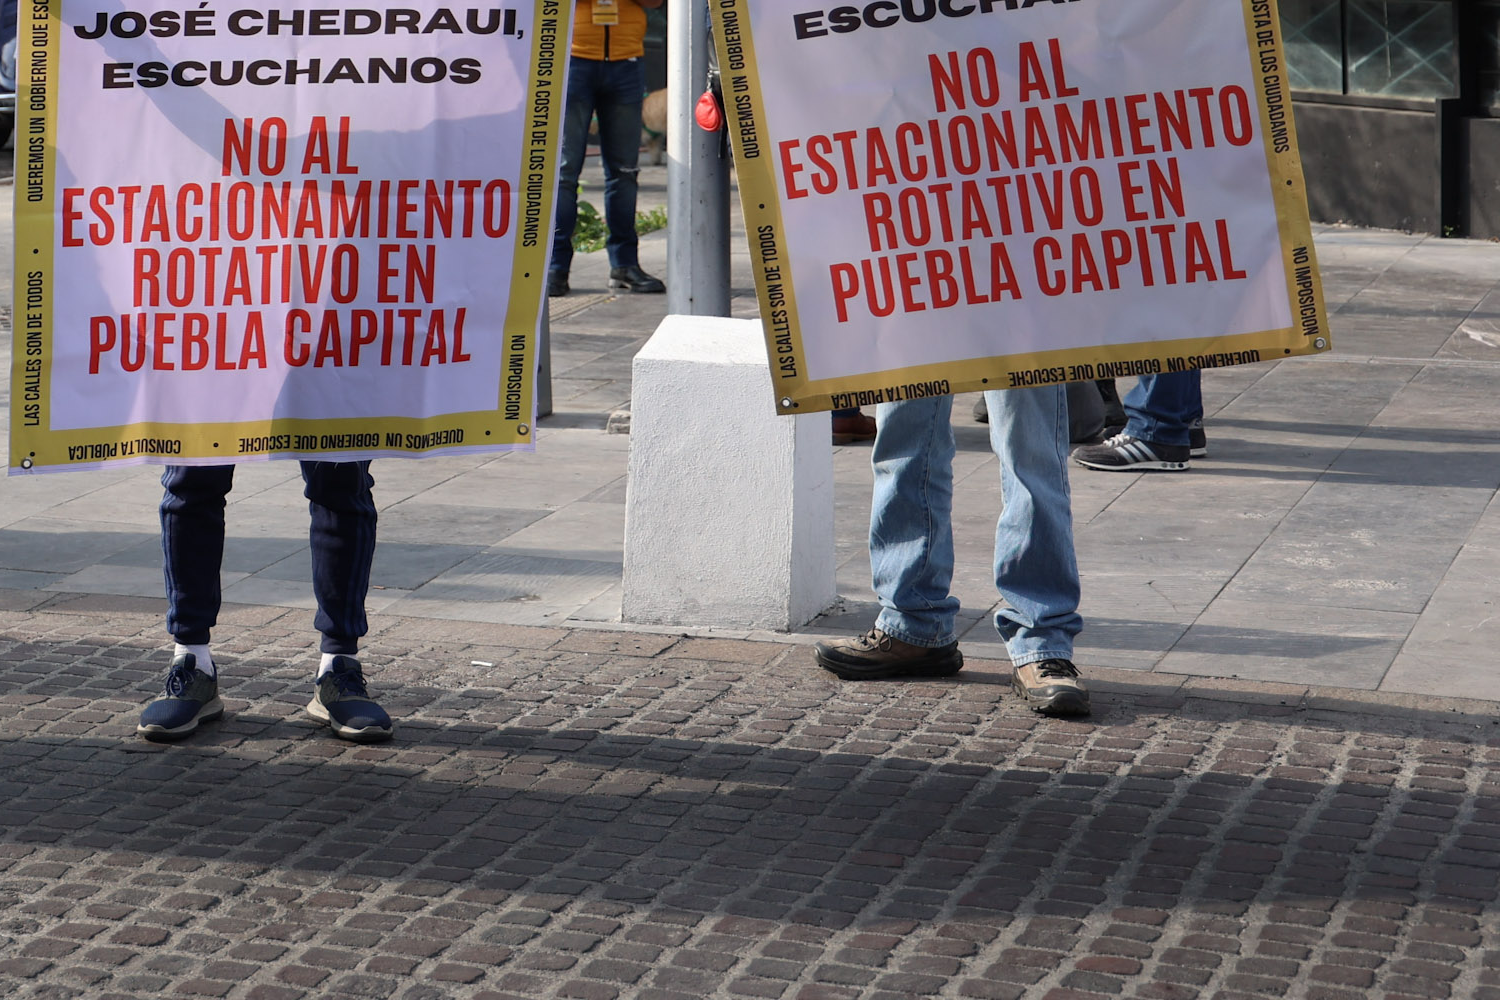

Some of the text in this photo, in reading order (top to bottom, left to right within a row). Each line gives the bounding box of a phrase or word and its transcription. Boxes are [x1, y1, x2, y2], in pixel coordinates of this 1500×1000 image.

[72, 1, 524, 40] JOSÉ CHEDRAUI,
[536, 18, 557, 77] NEGOCIOS
[1255, 29, 1275, 48] DE
[102, 56, 482, 89] ESCUCHANOS
[535, 79, 552, 88] A
[927, 37, 1080, 113] NO AL
[1258, 48, 1278, 74] LOS
[530, 130, 547, 146] DE
[531, 90, 551, 128] COSTA
[1262, 74, 1290, 154] CIUDADANOS
[221, 115, 356, 177] NO AL
[528, 148, 546, 171] LOS
[779, 84, 1253, 200] ESTACIONAMIENTO
[61, 178, 511, 247] ESTACIONAMIENTO
[521, 173, 543, 247] CIUDADANOS
[861, 156, 1185, 252] ROTATIVO EN
[132, 243, 436, 308] ROTATIVO EN
[828, 218, 1247, 322] PUEBLA CAPITAL
[88, 306, 471, 375] PUEBLA CAPITAL
[504, 334, 526, 420] NO IMPOSICION
